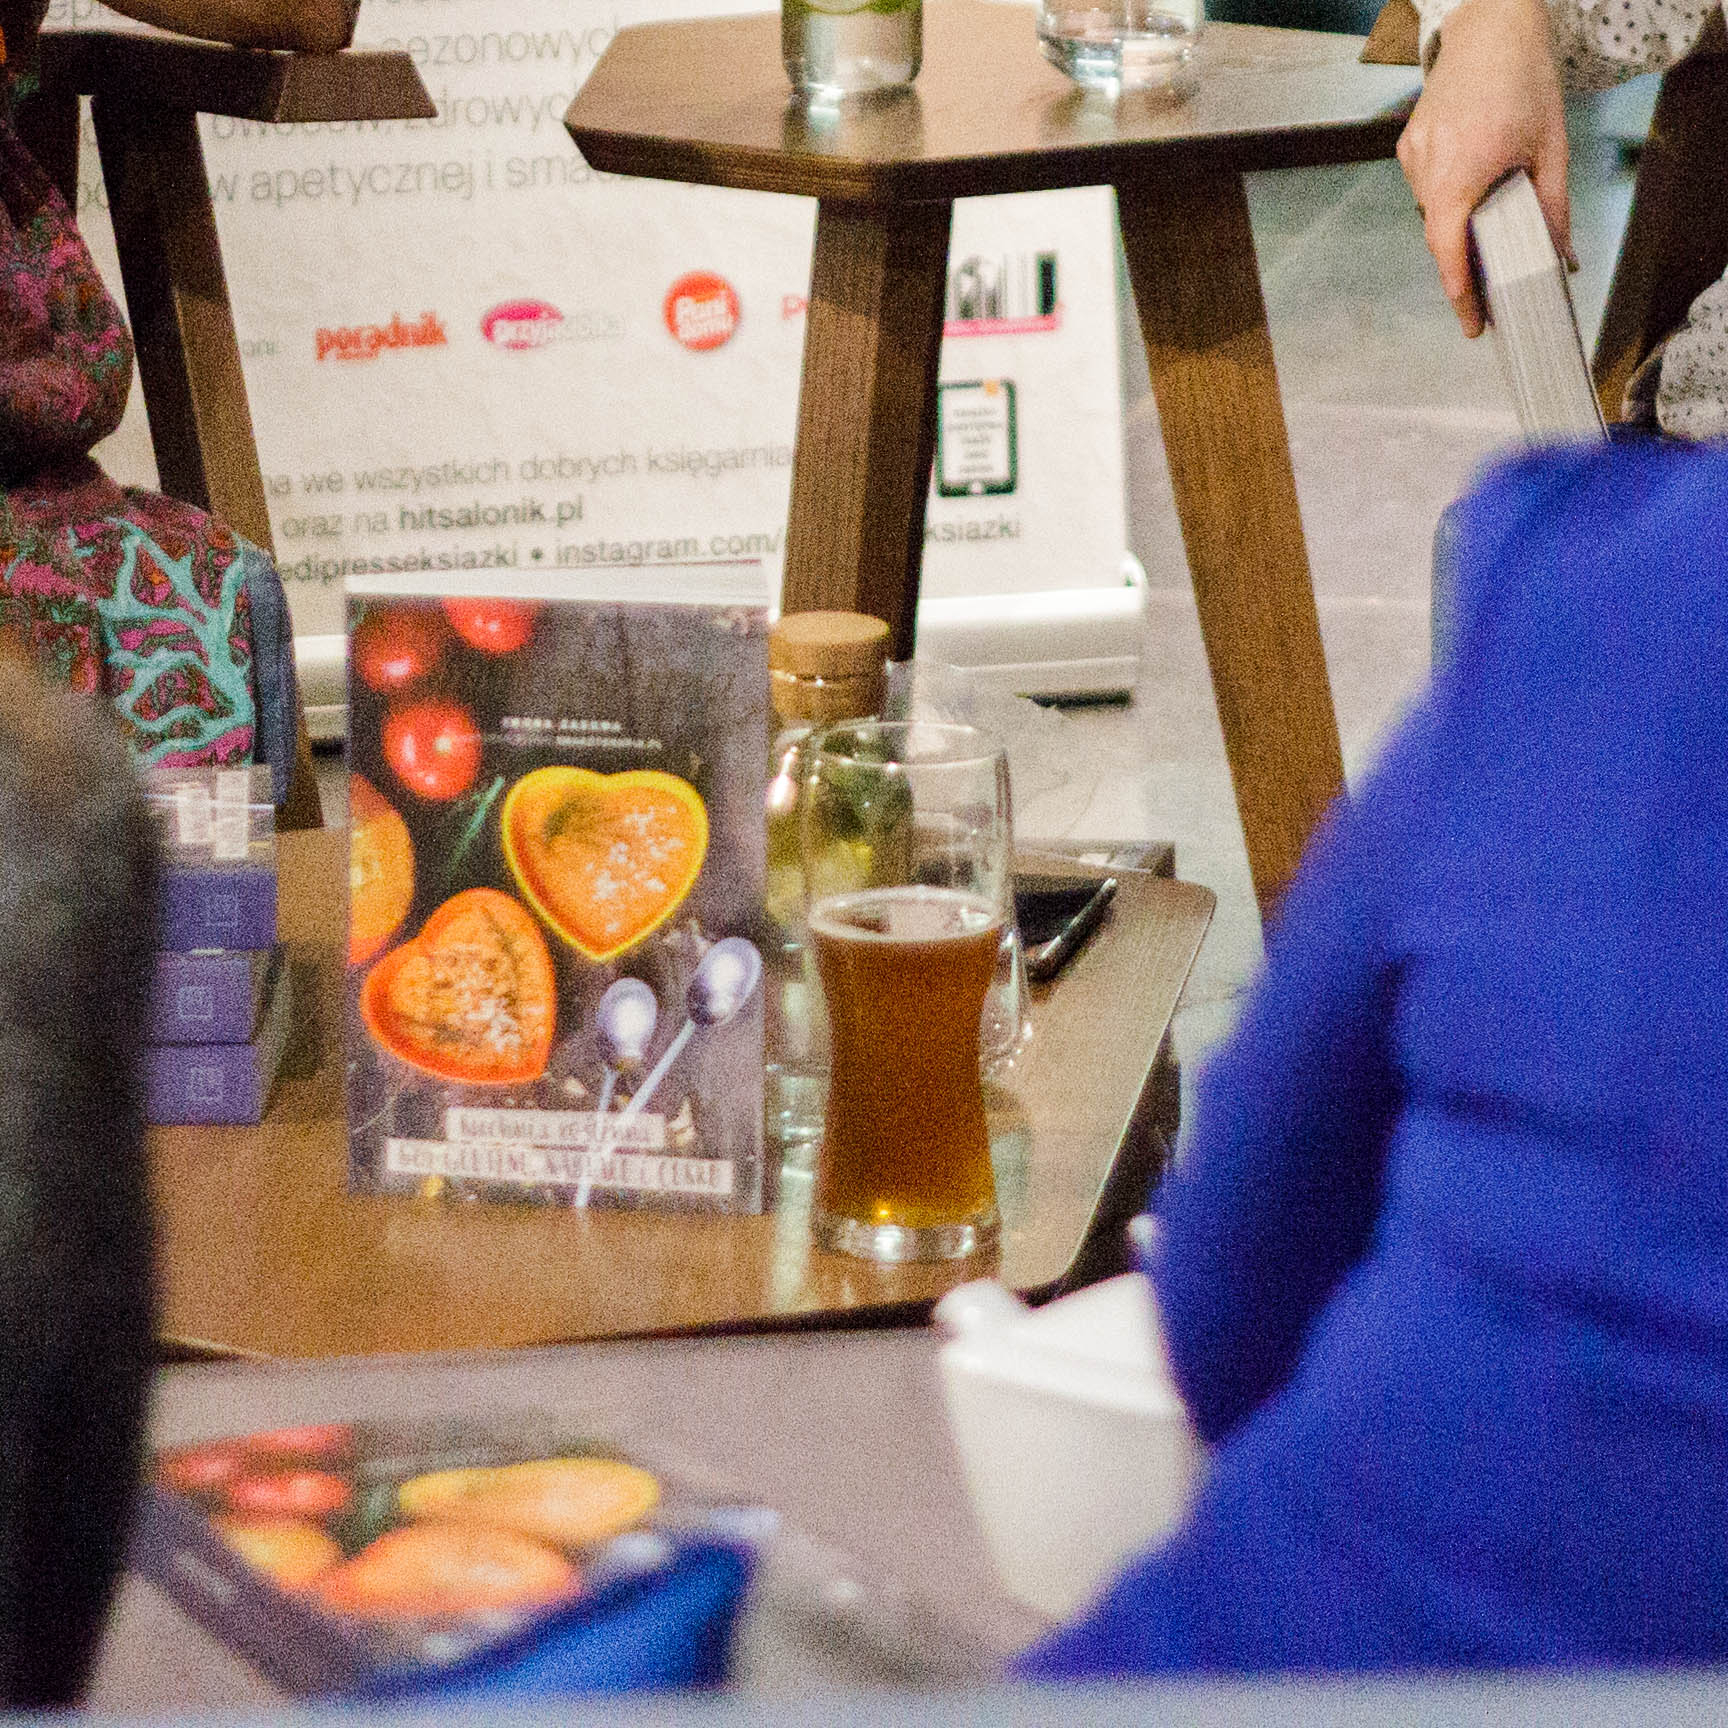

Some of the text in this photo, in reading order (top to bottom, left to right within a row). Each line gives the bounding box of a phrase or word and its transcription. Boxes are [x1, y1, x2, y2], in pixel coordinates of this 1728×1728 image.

[249, 153, 476, 207] apetycznej
[302, 469, 345, 494] we
[355, 455, 510, 494] wszystkich
[519, 449, 638, 485] dobrych
[647, 444, 792, 478] księgarnia
[280, 494, 585, 539] oraz na hitsalonik.pl
